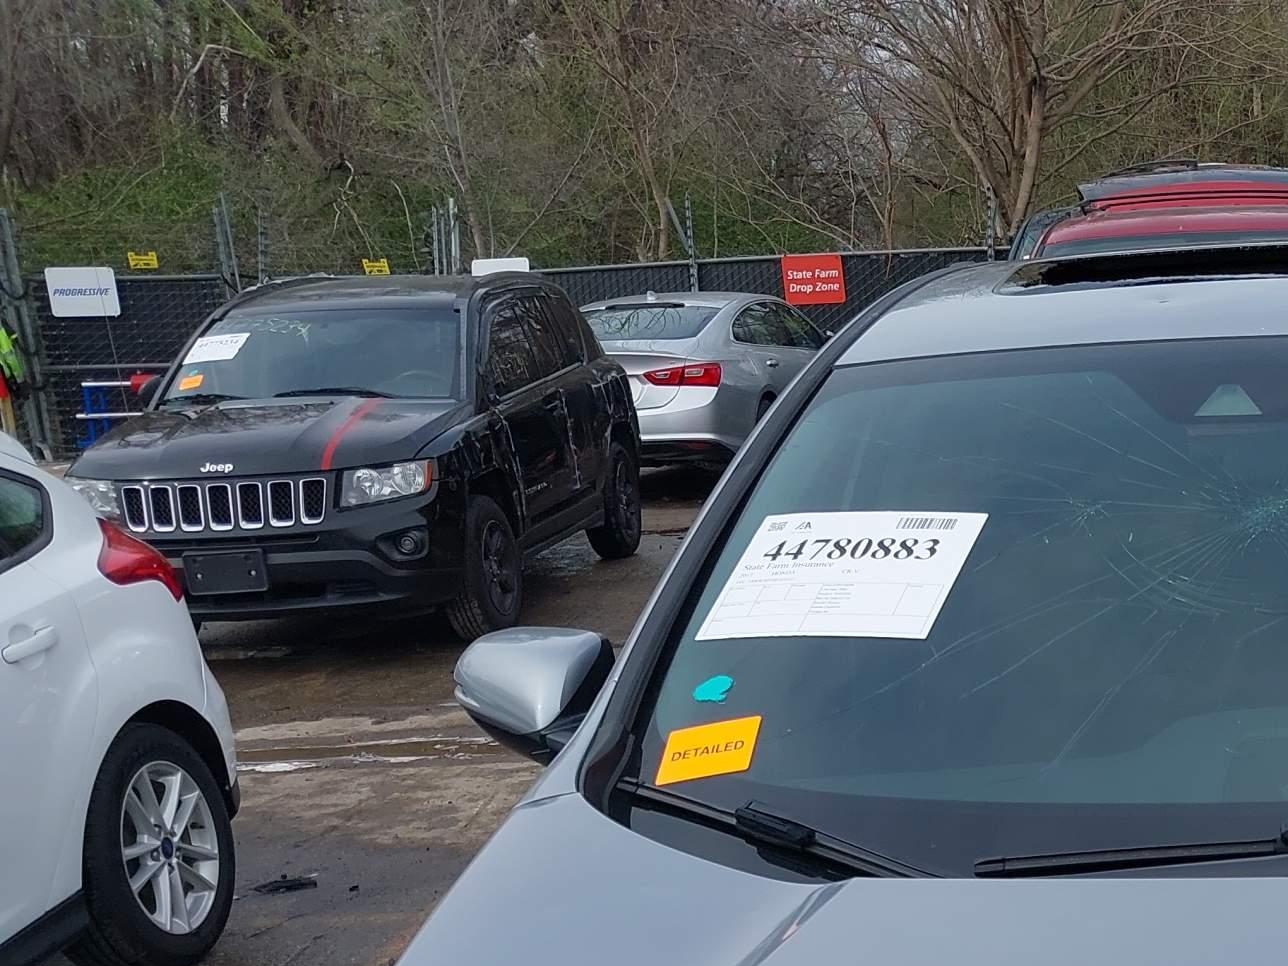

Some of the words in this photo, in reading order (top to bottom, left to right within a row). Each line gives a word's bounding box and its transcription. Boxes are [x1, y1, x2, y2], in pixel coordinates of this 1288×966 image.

[787, 270, 813, 280] State
[815, 268, 839, 278] Farm
[53, 287, 111, 297] PROGRESSIVE
[789, 283, 813, 294] Drop
[815, 282, 840, 291] Zone
[200, 462, 234, 474] Jeep
[763, 537, 941, 561] 44780883
[744, 563, 765, 571] State
[766, 562, 790, 570] Farm
[671, 740, 745, 762] DETAILED
